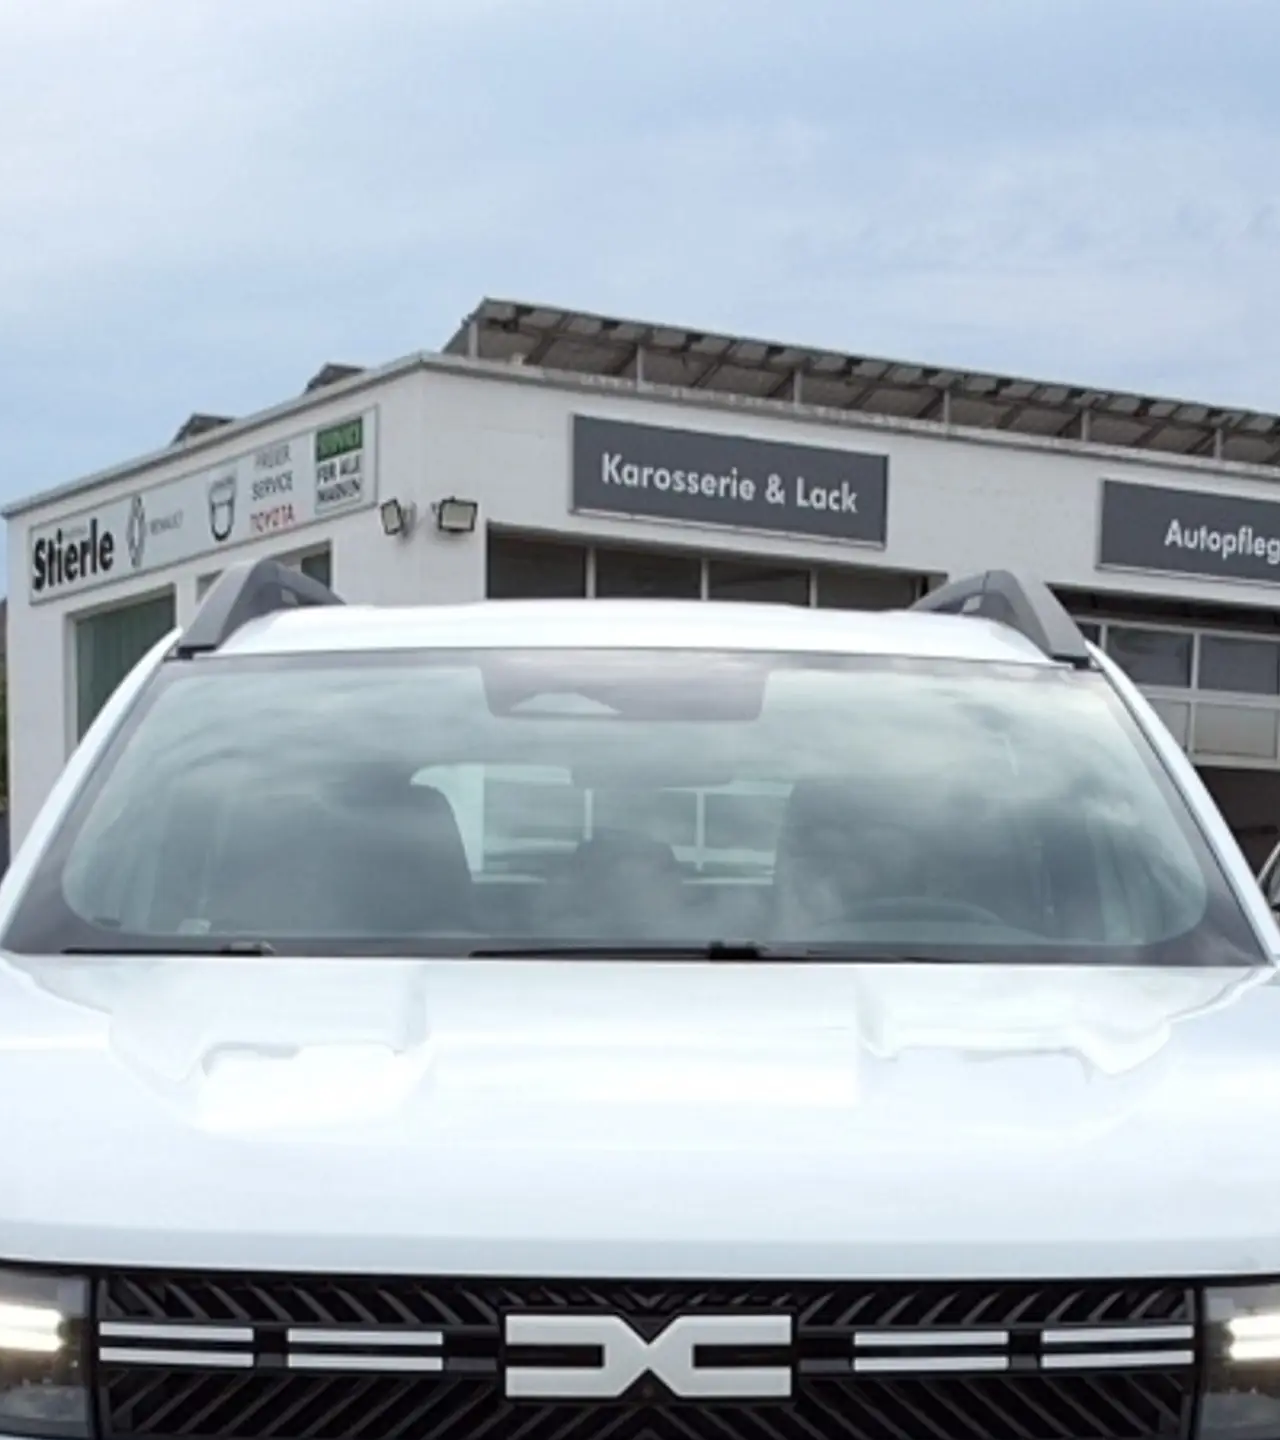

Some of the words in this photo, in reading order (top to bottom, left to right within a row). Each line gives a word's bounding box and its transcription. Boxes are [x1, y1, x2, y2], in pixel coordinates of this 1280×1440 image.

[251, 470, 294, 501] SERVICE
[601, 451, 755, 502] Karosserie
[765, 475, 786, 506] &
[796, 477, 859, 514] Lack
[250, 504, 296, 533] TOYOTA
[33, 517, 115, 592] Stierle
